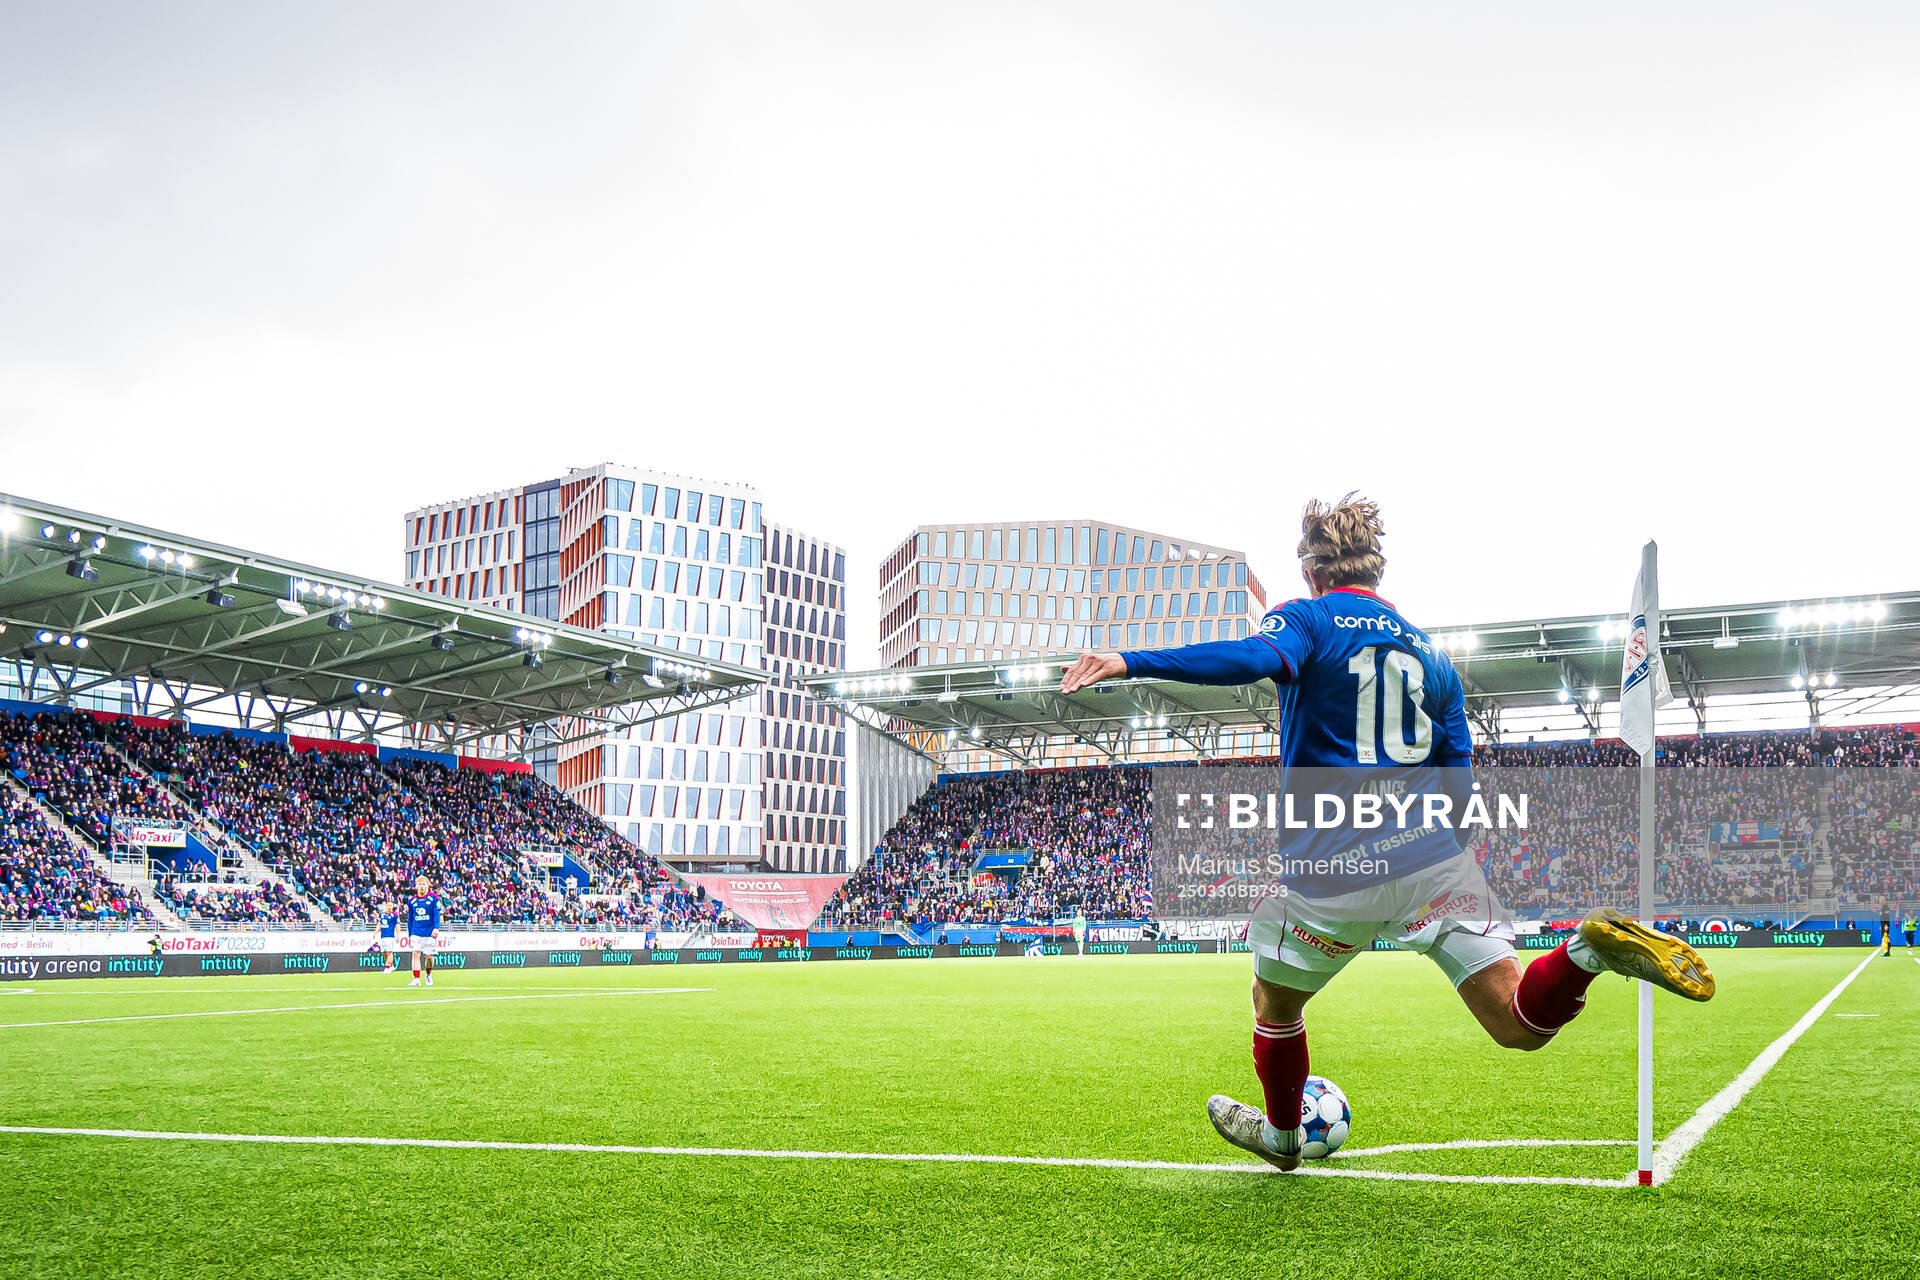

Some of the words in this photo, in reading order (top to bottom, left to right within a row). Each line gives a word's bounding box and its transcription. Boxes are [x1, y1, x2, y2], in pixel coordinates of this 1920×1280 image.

[1348, 646, 1433, 765] 10
[729, 880, 783, 891] TOYOTA
[27, 940, 53, 949] Bestill
[162, 937, 216, 951] sloTaxi
[227, 937, 266, 950] 02323
[1688, 931, 1738, 948] intility
[1773, 930, 1825, 947] intility
[836, 947, 872, 960] intility
[896, 946, 934, 959] intility
[959, 945, 997, 958] intility
[1089, 943, 1129, 955] intility
[1157, 941, 1198, 954] intility
[359, 953, 401, 971] intily
[434, 952, 467, 969] ntility
[491, 952, 526, 968] intility
[549, 952, 581, 966] intility
[602, 951, 633, 965] intility
[651, 950, 679, 964] intility
[696, 949, 723, 963] intility
[738, 949, 763, 962] intility
[45, 960, 101, 974] arena
[107, 955, 164, 977] intility
[201, 954, 251, 974] intility
[283, 954, 330, 972] intility
